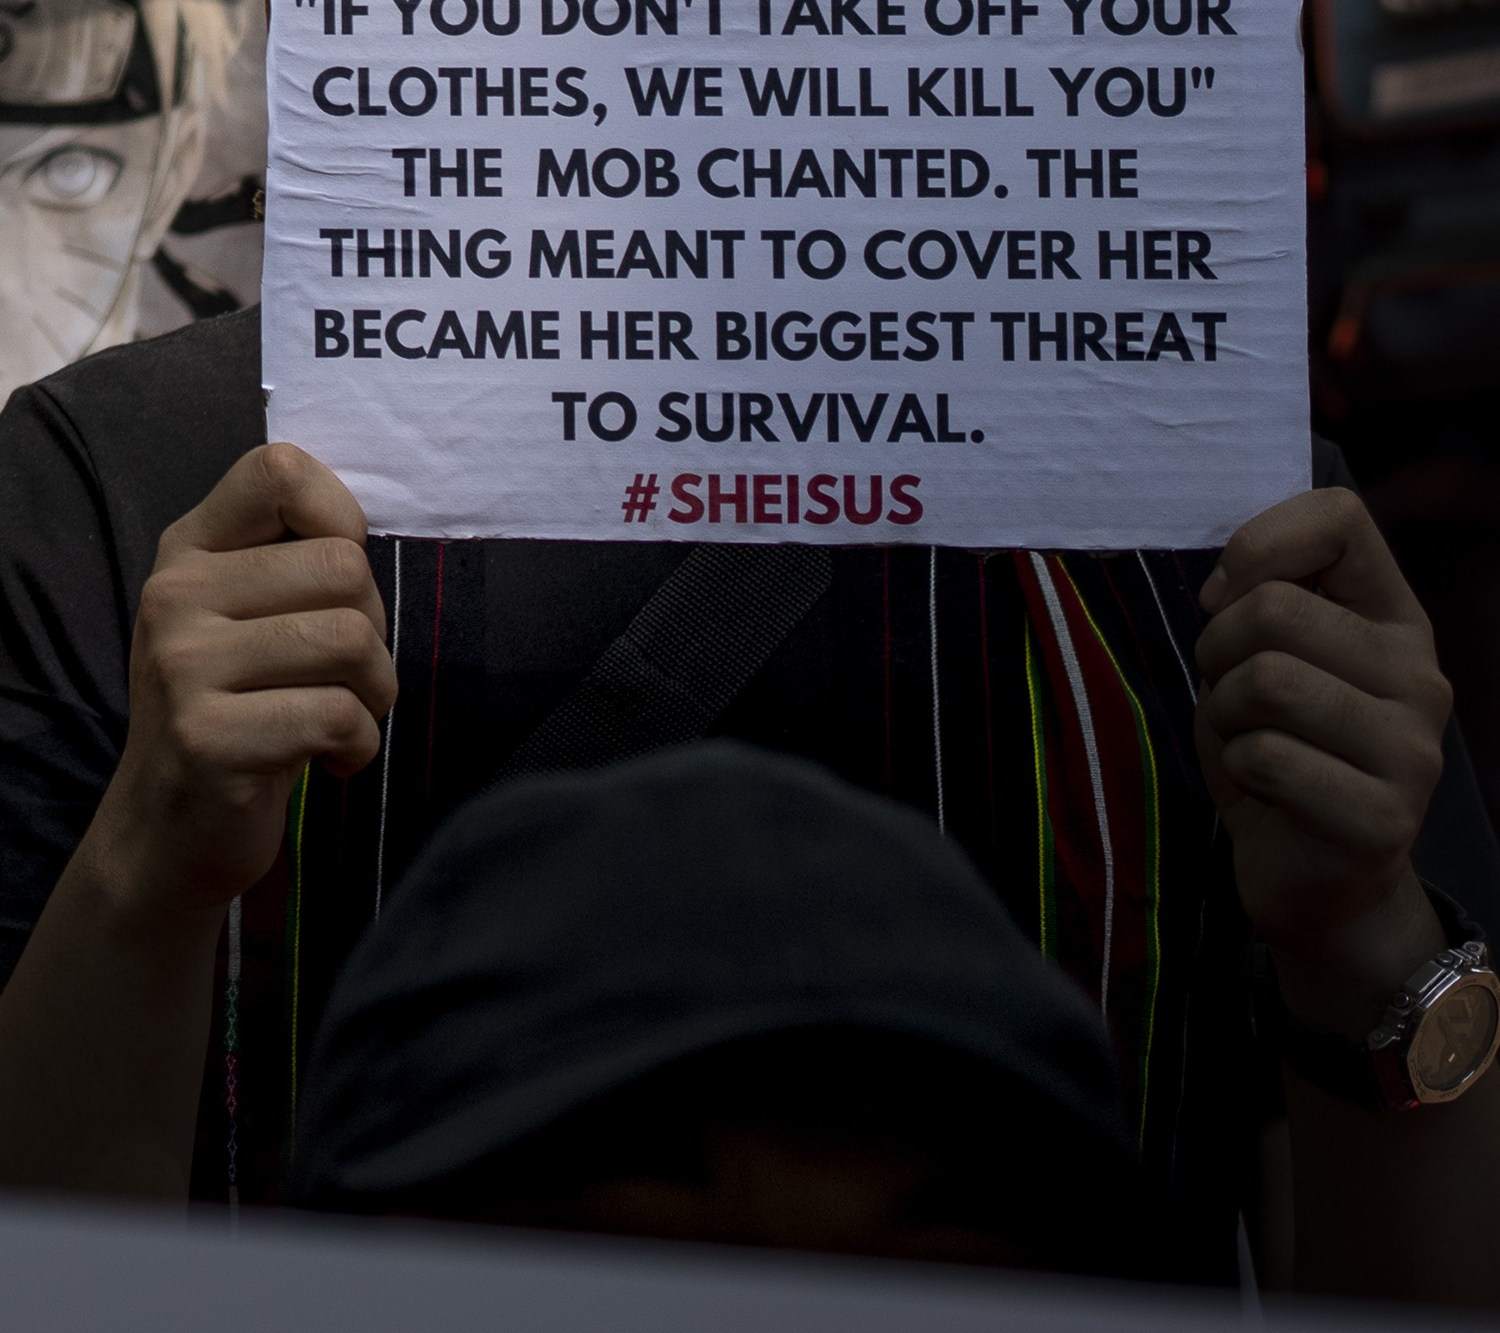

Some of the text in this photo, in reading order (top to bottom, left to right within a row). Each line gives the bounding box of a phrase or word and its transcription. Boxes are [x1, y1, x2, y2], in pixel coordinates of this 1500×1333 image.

[311, 65, 1216, 128] CLOTHES, WE WILL KILL YOU"
[389, 146, 1140, 200] THE MOB CHANTED. THE
[318, 226, 1219, 282] THING MEANT TO COVER HER
[313, 307, 1228, 363] BECAME HER BIGGEST THREAT
[550, 390, 986, 445] TO SURVIVAL.
[620, 472, 925, 527] #SHEISUS
